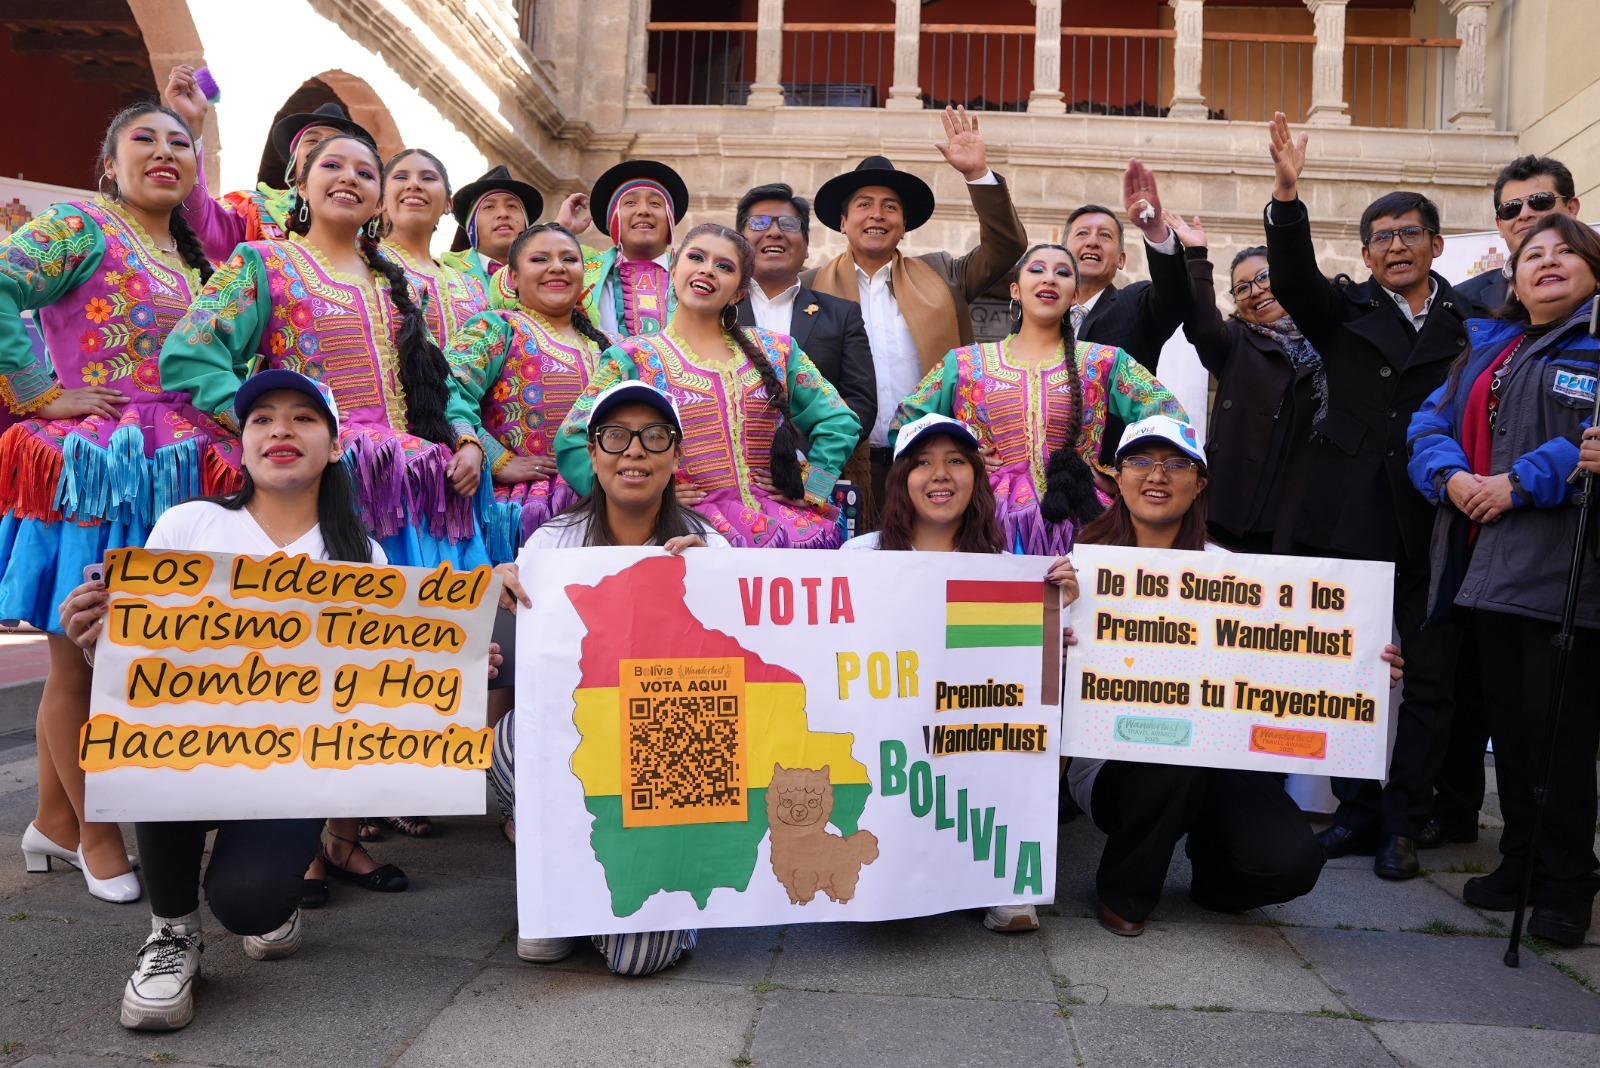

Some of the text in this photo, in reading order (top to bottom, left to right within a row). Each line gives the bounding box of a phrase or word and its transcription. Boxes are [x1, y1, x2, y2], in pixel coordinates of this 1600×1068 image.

[233, 556, 397, 599] Líderes
[419, 567, 484, 605] del
[738, 576, 855, 626] VOTA
[1097, 568, 1345, 611] De los Sueños a los
[114, 601, 460, 648] Turismo Tienen
[1097, 613, 1352, 656] Premios: Wanderlust
[129, 655, 460, 712] Nombre y Hoy
[640, 680, 727, 693] VOTA AQUI
[836, 650, 919, 700] POR
[936, 679, 1023, 711] Premios:
[1081, 672, 1375, 722] Reconoce tu Trayectoria
[81, 721, 489, 765] Hacemos Historia!
[923, 722, 1047, 754] Wanderlust
[1125, 718, 1178, 732] Wanderlust
[880, 739, 1043, 895] BOLIVIA
